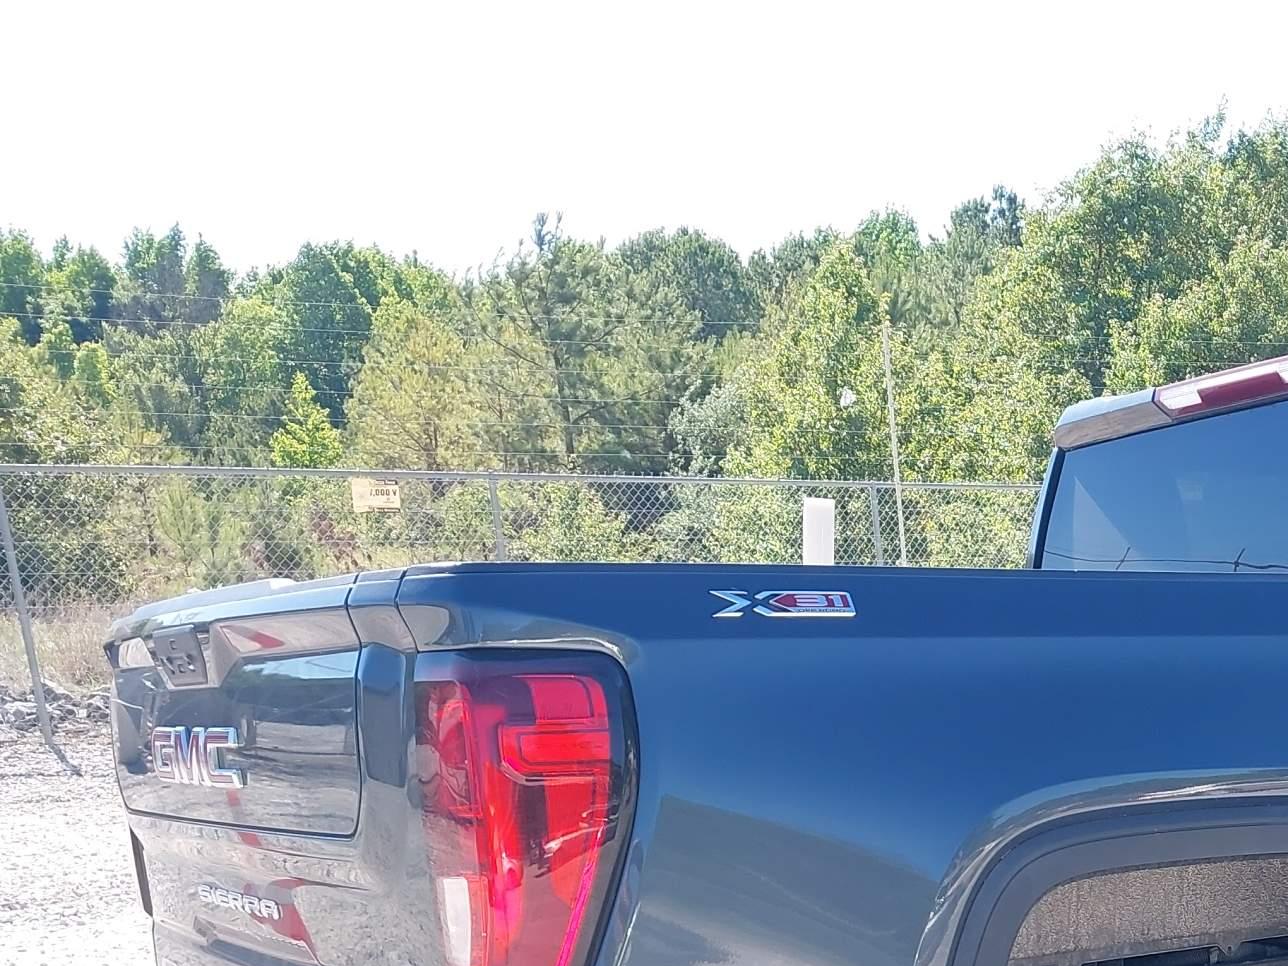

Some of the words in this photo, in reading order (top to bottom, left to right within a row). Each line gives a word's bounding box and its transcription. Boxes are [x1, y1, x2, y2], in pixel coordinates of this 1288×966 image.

[709, 590, 857, 617] X31
[151, 725, 245, 788] GMC
[198, 883, 281, 920] SIERRA
